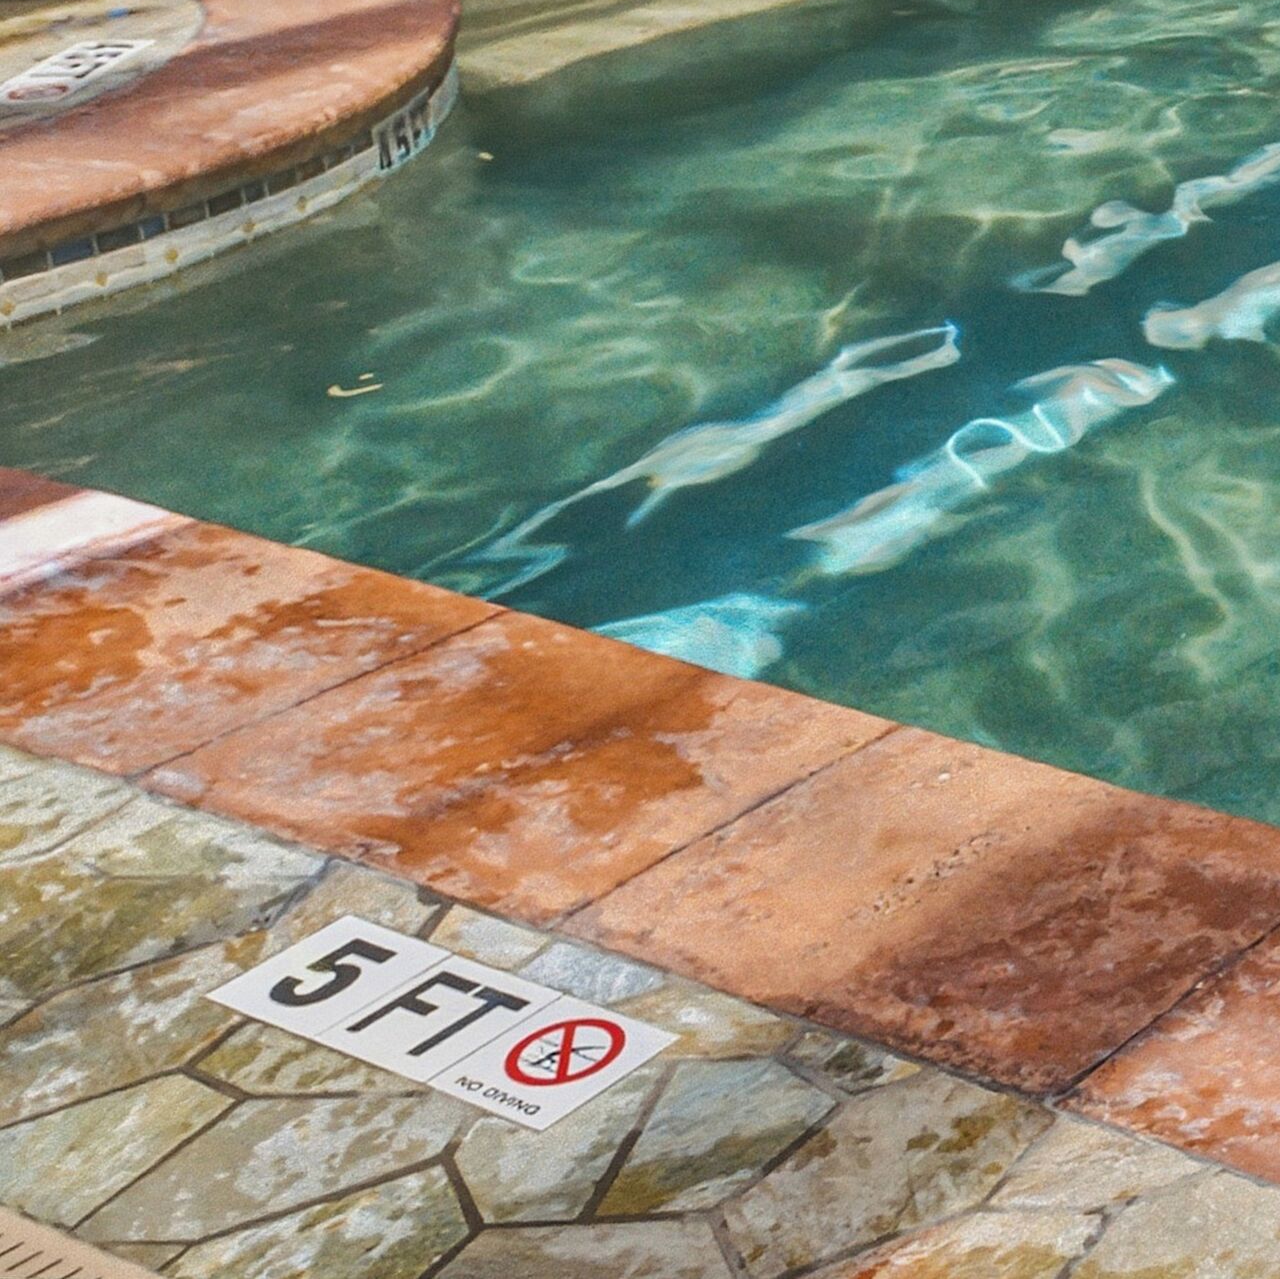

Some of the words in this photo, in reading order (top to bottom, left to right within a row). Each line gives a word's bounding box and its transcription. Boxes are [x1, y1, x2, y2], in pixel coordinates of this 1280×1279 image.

[268, 937, 397, 1008] 5
[346, 970, 531, 1057] FT
[455, 1076, 484, 1092] NO
[482, 1087, 541, 1116] DIVING
